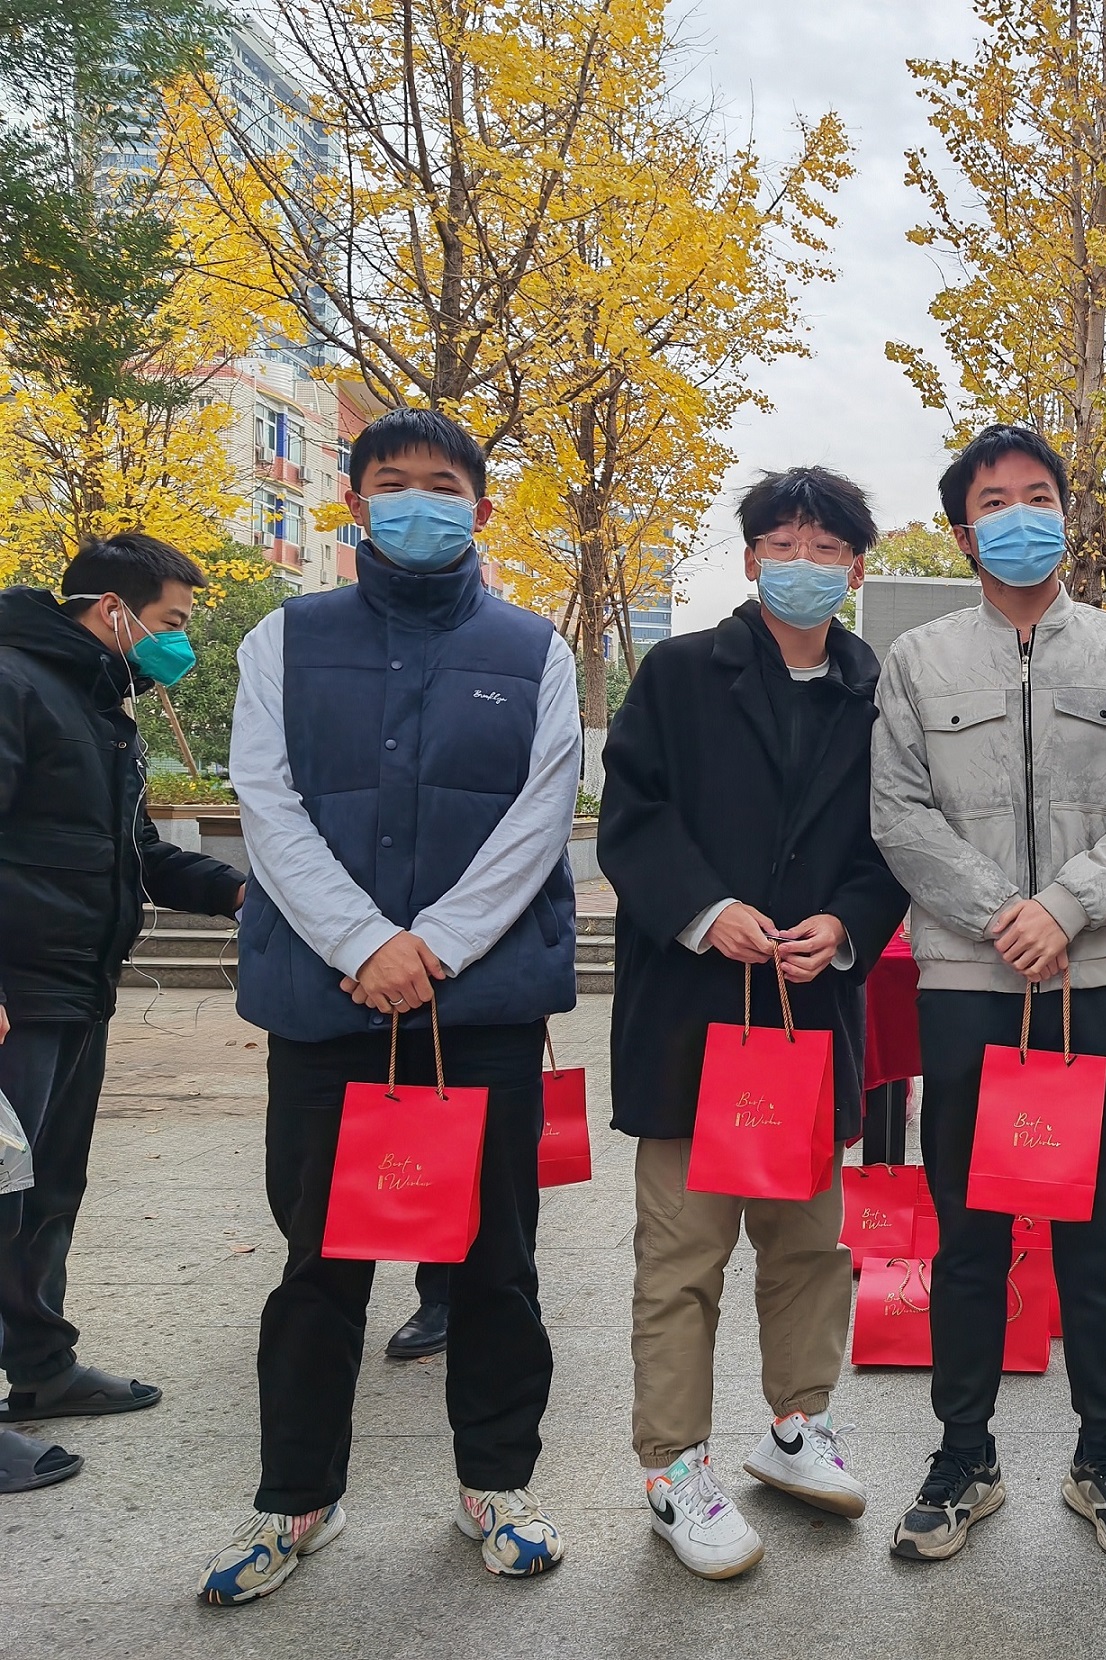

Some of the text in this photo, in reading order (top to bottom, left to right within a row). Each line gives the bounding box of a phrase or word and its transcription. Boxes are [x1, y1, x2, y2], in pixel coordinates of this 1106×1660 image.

[735, 1091, 766, 1112] Best
[1013, 1112, 1043, 1132] Best
[378, 1153, 413, 1174] Best
